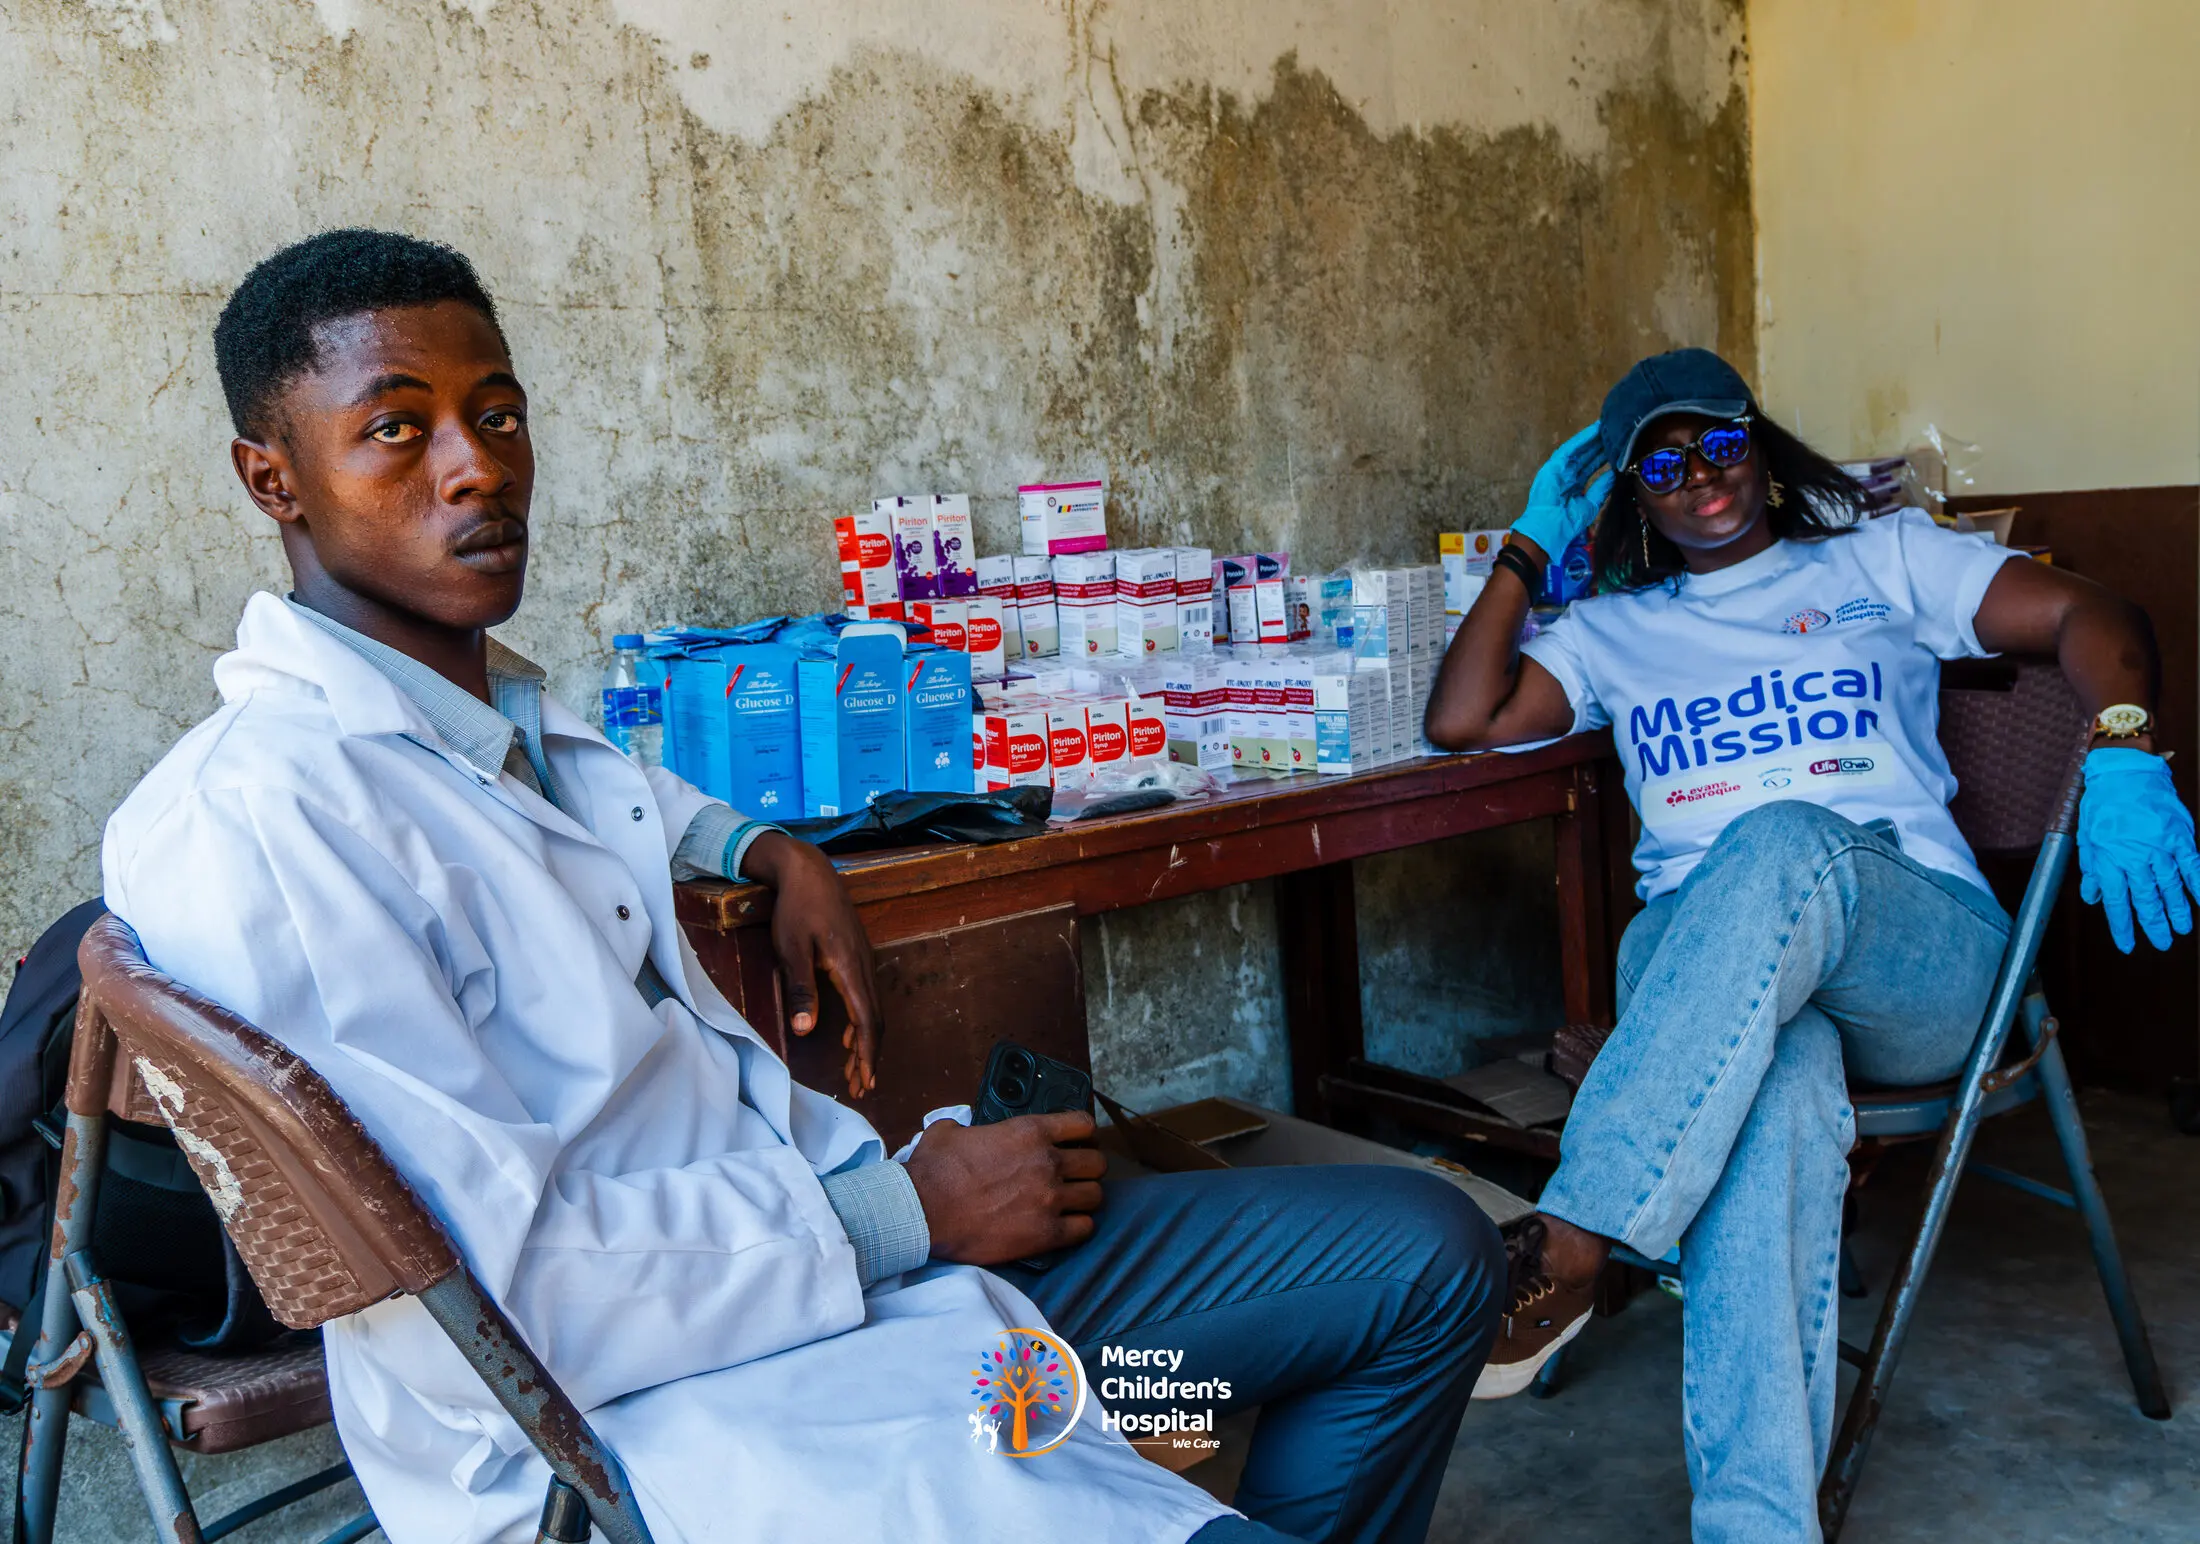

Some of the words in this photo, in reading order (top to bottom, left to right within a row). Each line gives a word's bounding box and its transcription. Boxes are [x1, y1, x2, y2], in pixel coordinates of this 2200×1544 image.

[898, 517, 928, 526] Piriton
[937, 514, 967, 523] Piriton
[934, 628, 962, 638] Piriton
[969, 624, 997, 632] Piriton
[735, 696, 782, 709] Glucose
[785, 693, 794, 705] D
[844, 697, 884, 708] Glucose
[887, 694, 896, 705] D
[916, 691, 954, 704] Glucose
[957, 688, 966, 699] D
[1631, 662, 1882, 745] Medical
[1133, 726, 1160, 736] Piriton
[1053, 736, 1081, 747] Piriton
[1093, 732, 1121, 742] Piriton
[1010, 742, 1041, 753] Piriton
[1637, 704, 1879, 782] Mission
[1690, 781, 1728, 795] evans
[1687, 785, 1741, 803] baroque
